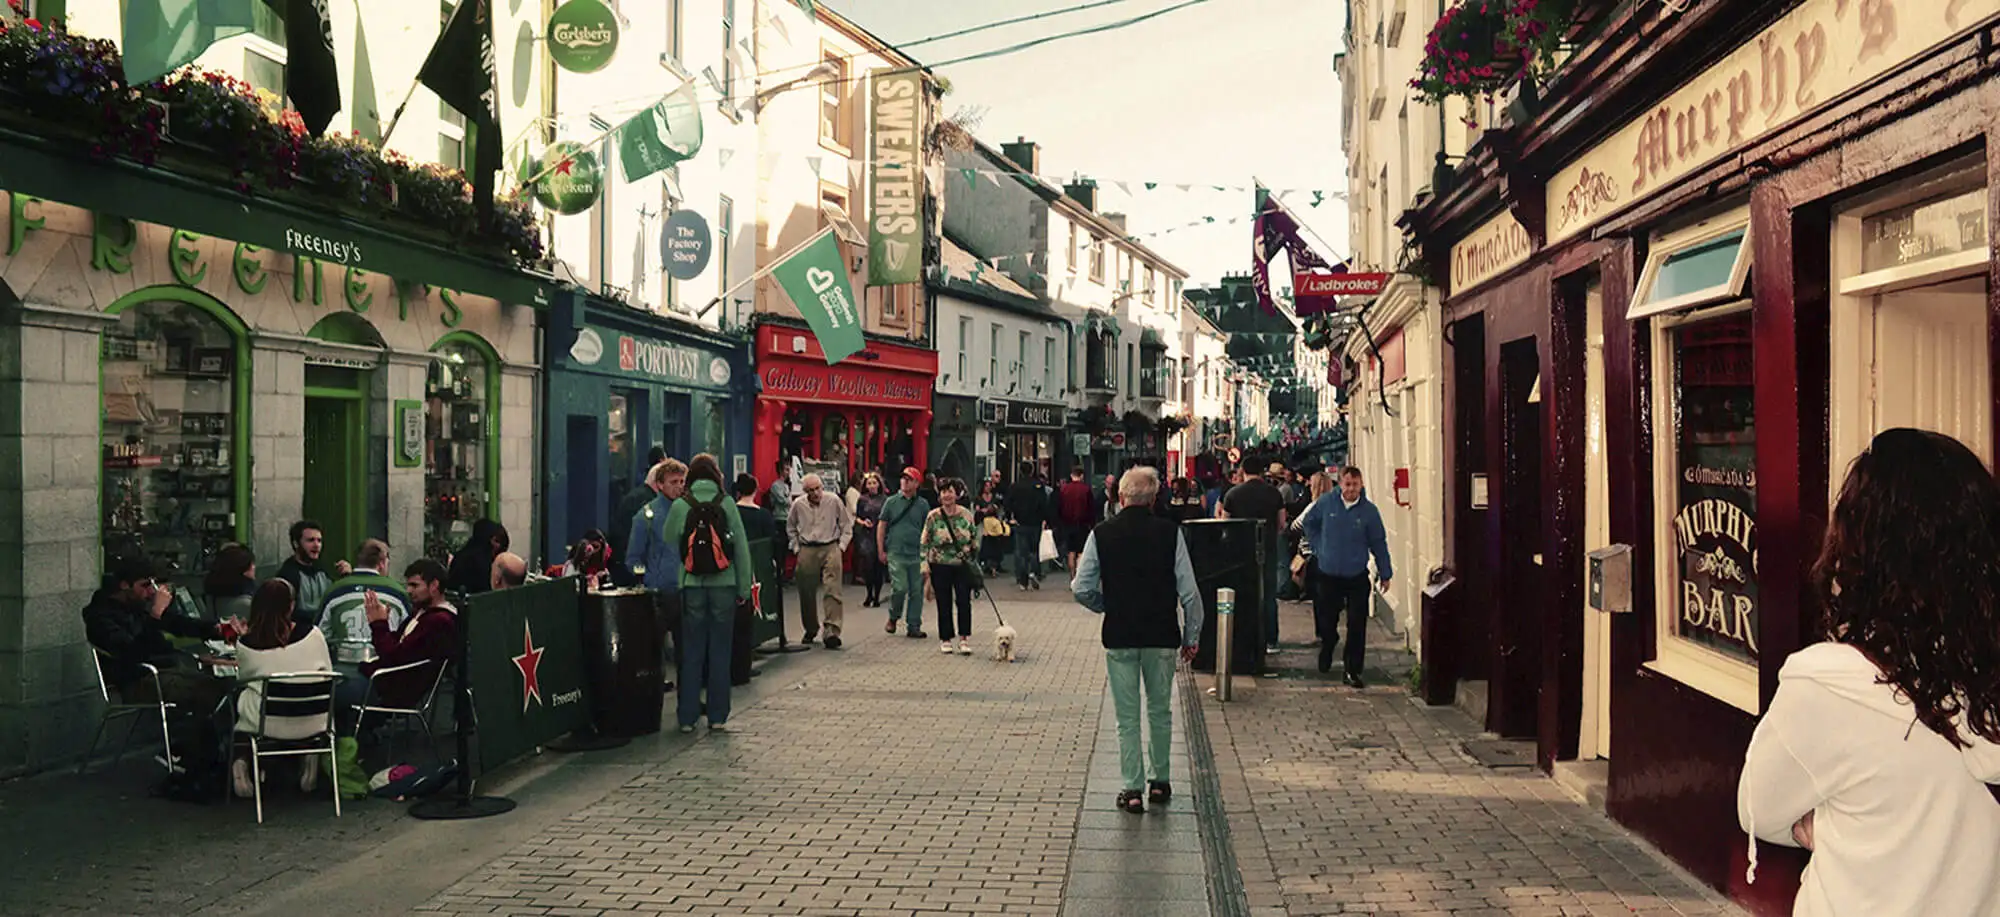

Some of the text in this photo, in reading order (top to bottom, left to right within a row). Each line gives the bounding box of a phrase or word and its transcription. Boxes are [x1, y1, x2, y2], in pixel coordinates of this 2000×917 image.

[554, 23, 611, 48] Carlsberg
[1632, 0, 1897, 194] Murphy's
[875, 79, 917, 235] SWEATERS
[536, 182, 594, 196] Heeken
[675, 226, 695, 237] The
[668, 237, 703, 251] Factory
[672, 250, 697, 264] Shop
[1309, 280, 1379, 291] Ladbrokes
[634, 341, 699, 380] PORTWEST
[766, 367, 823, 398] Galway
[828, 373, 879, 397] Woollen
[1022, 407, 1050, 424] CHOICE
[1683, 580, 1759, 653] BAR
